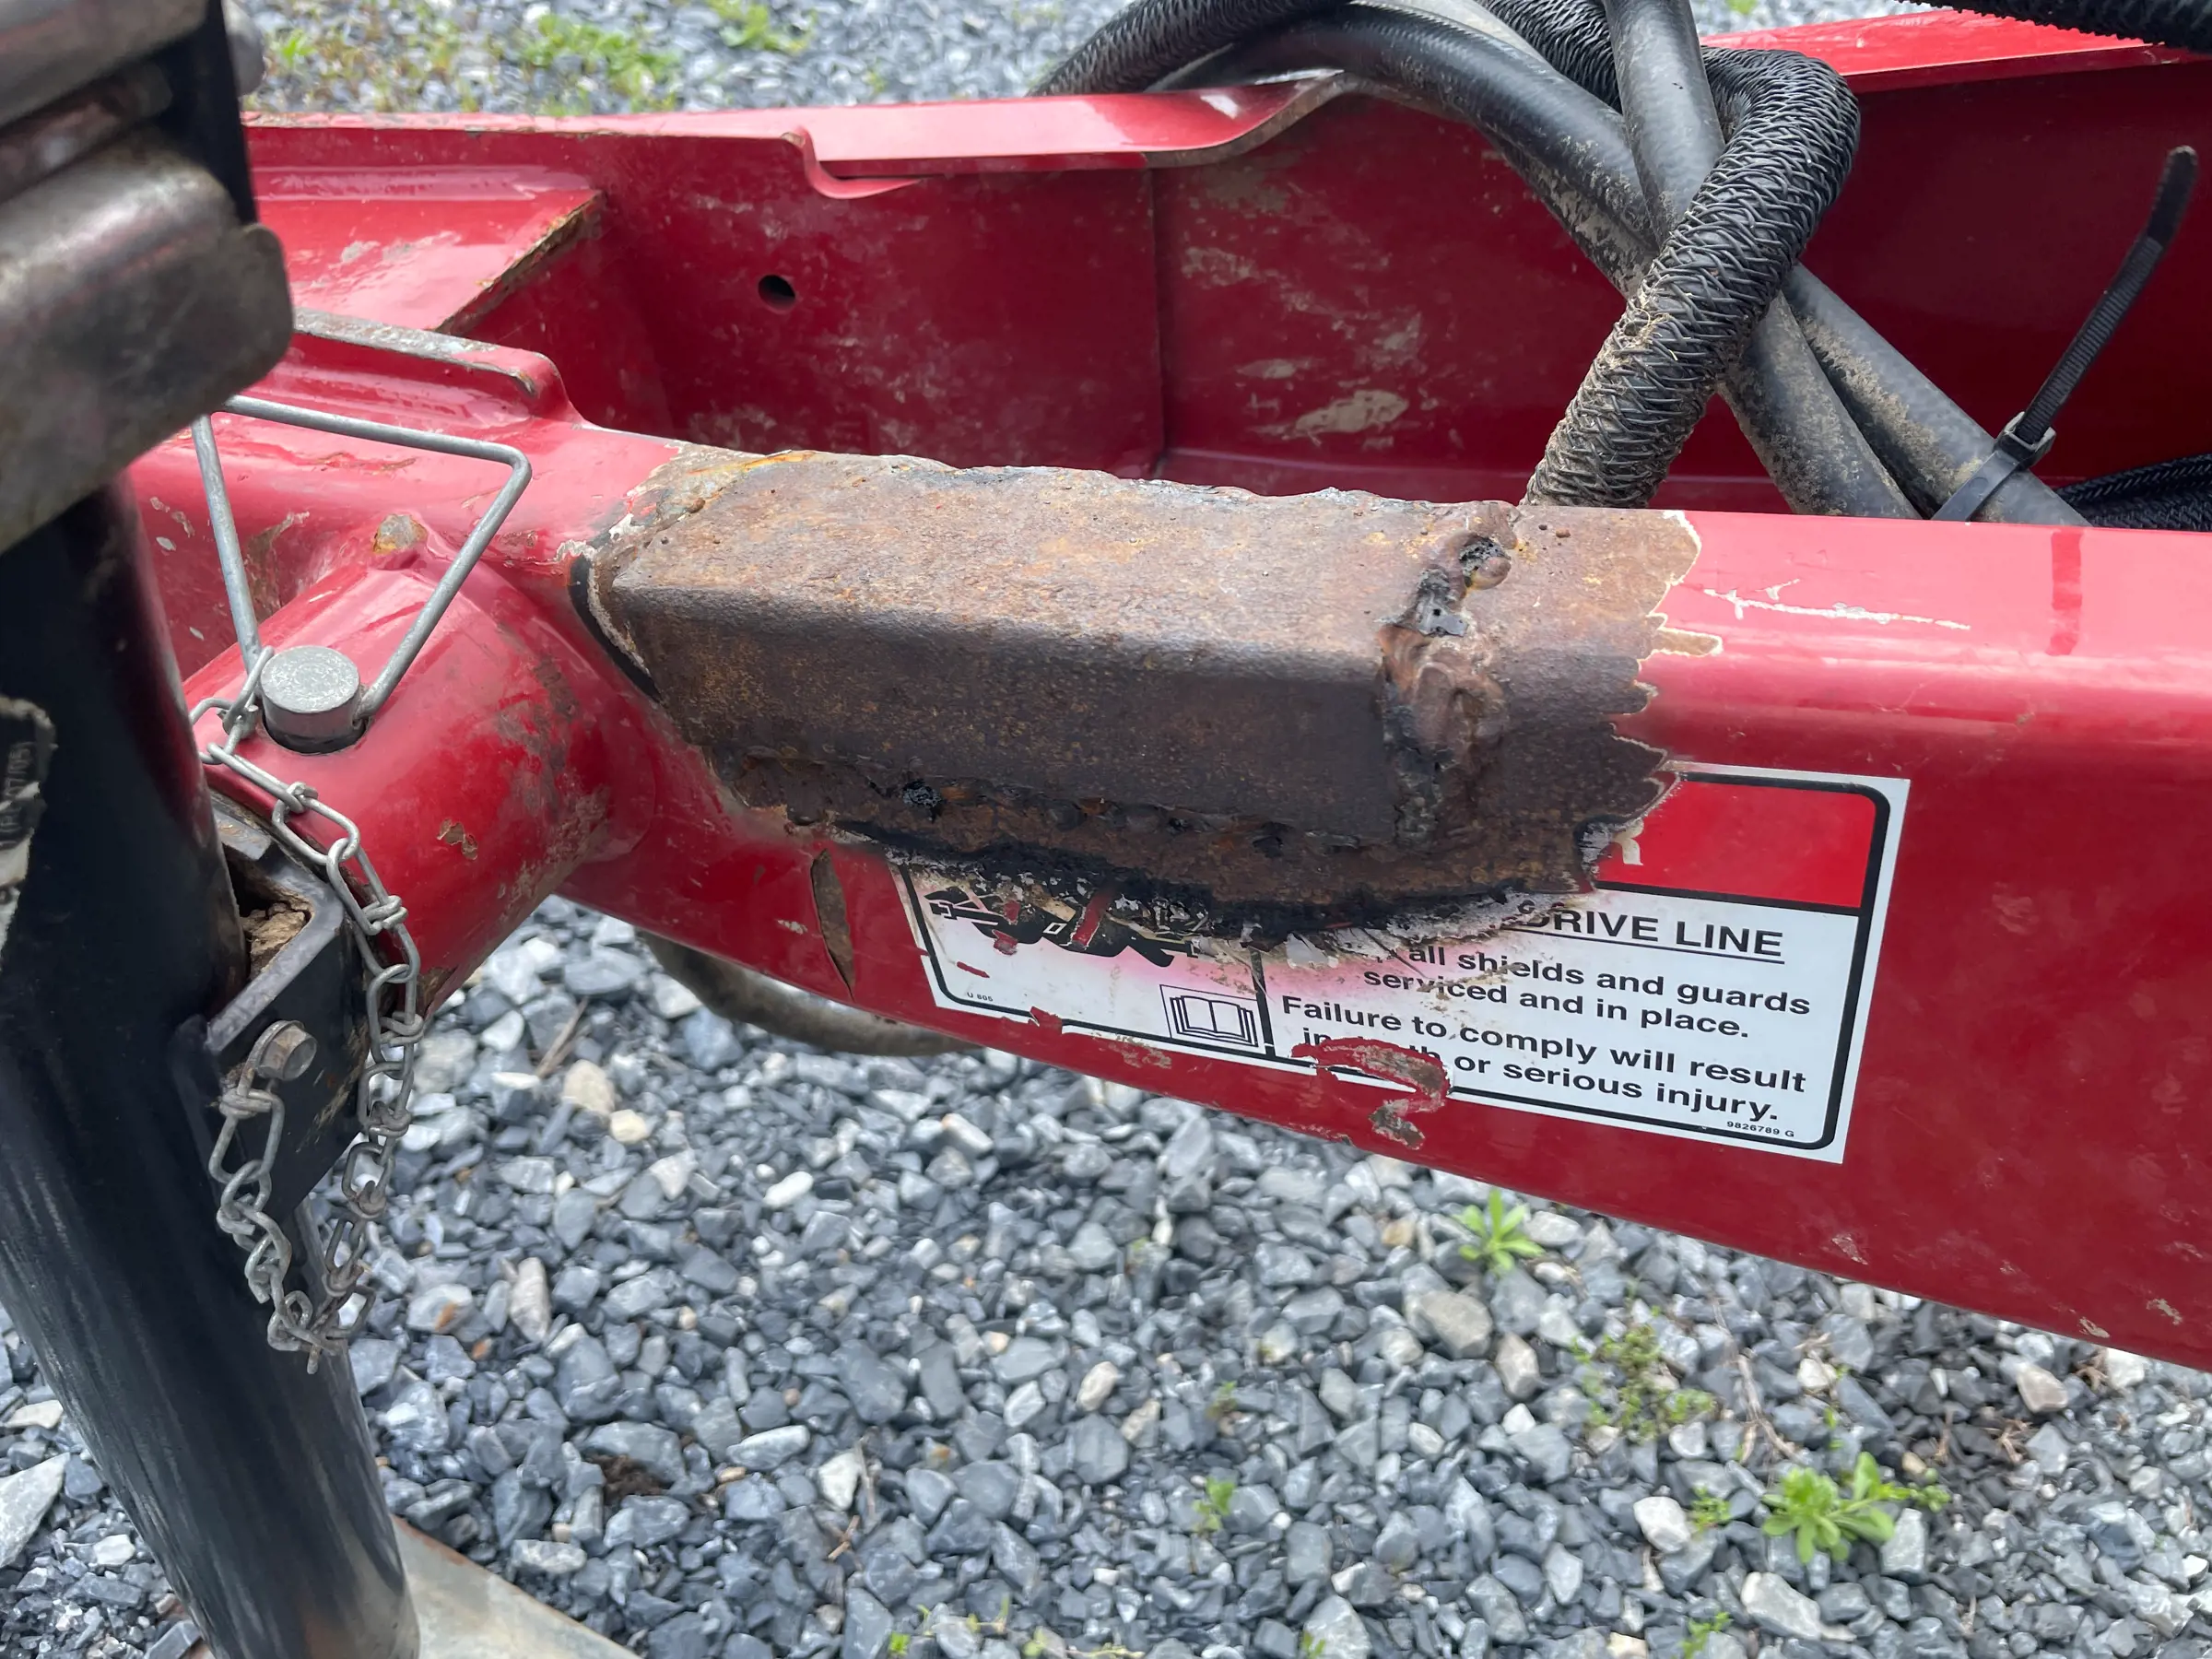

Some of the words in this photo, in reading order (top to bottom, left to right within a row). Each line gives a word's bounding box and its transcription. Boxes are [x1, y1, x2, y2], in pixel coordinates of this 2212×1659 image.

[1676, 921, 1783, 957] LINE
[1363, 971, 1508, 1004] serviced
[1519, 993, 1583, 1016] and
[1596, 998, 1628, 1021] in
[1641, 1007, 1748, 1038] place.
[1408, 946, 1446, 966] all
[1458, 951, 1584, 984] shields
[1596, 972, 1665, 996] and
[1677, 982, 1810, 1015] guards
[1282, 994, 1402, 1030] Failure
[1411, 1016, 1447, 1038] to
[1459, 1027, 1597, 1065] comply
[1610, 1048, 1675, 1073] will
[1689, 1060, 1806, 1093] result
[1453, 1055, 1491, 1074] or
[1503, 1063, 1642, 1099] serious
[1656, 1082, 1778, 1123] injury.
[1726, 1121, 1780, 1135] 9826789
